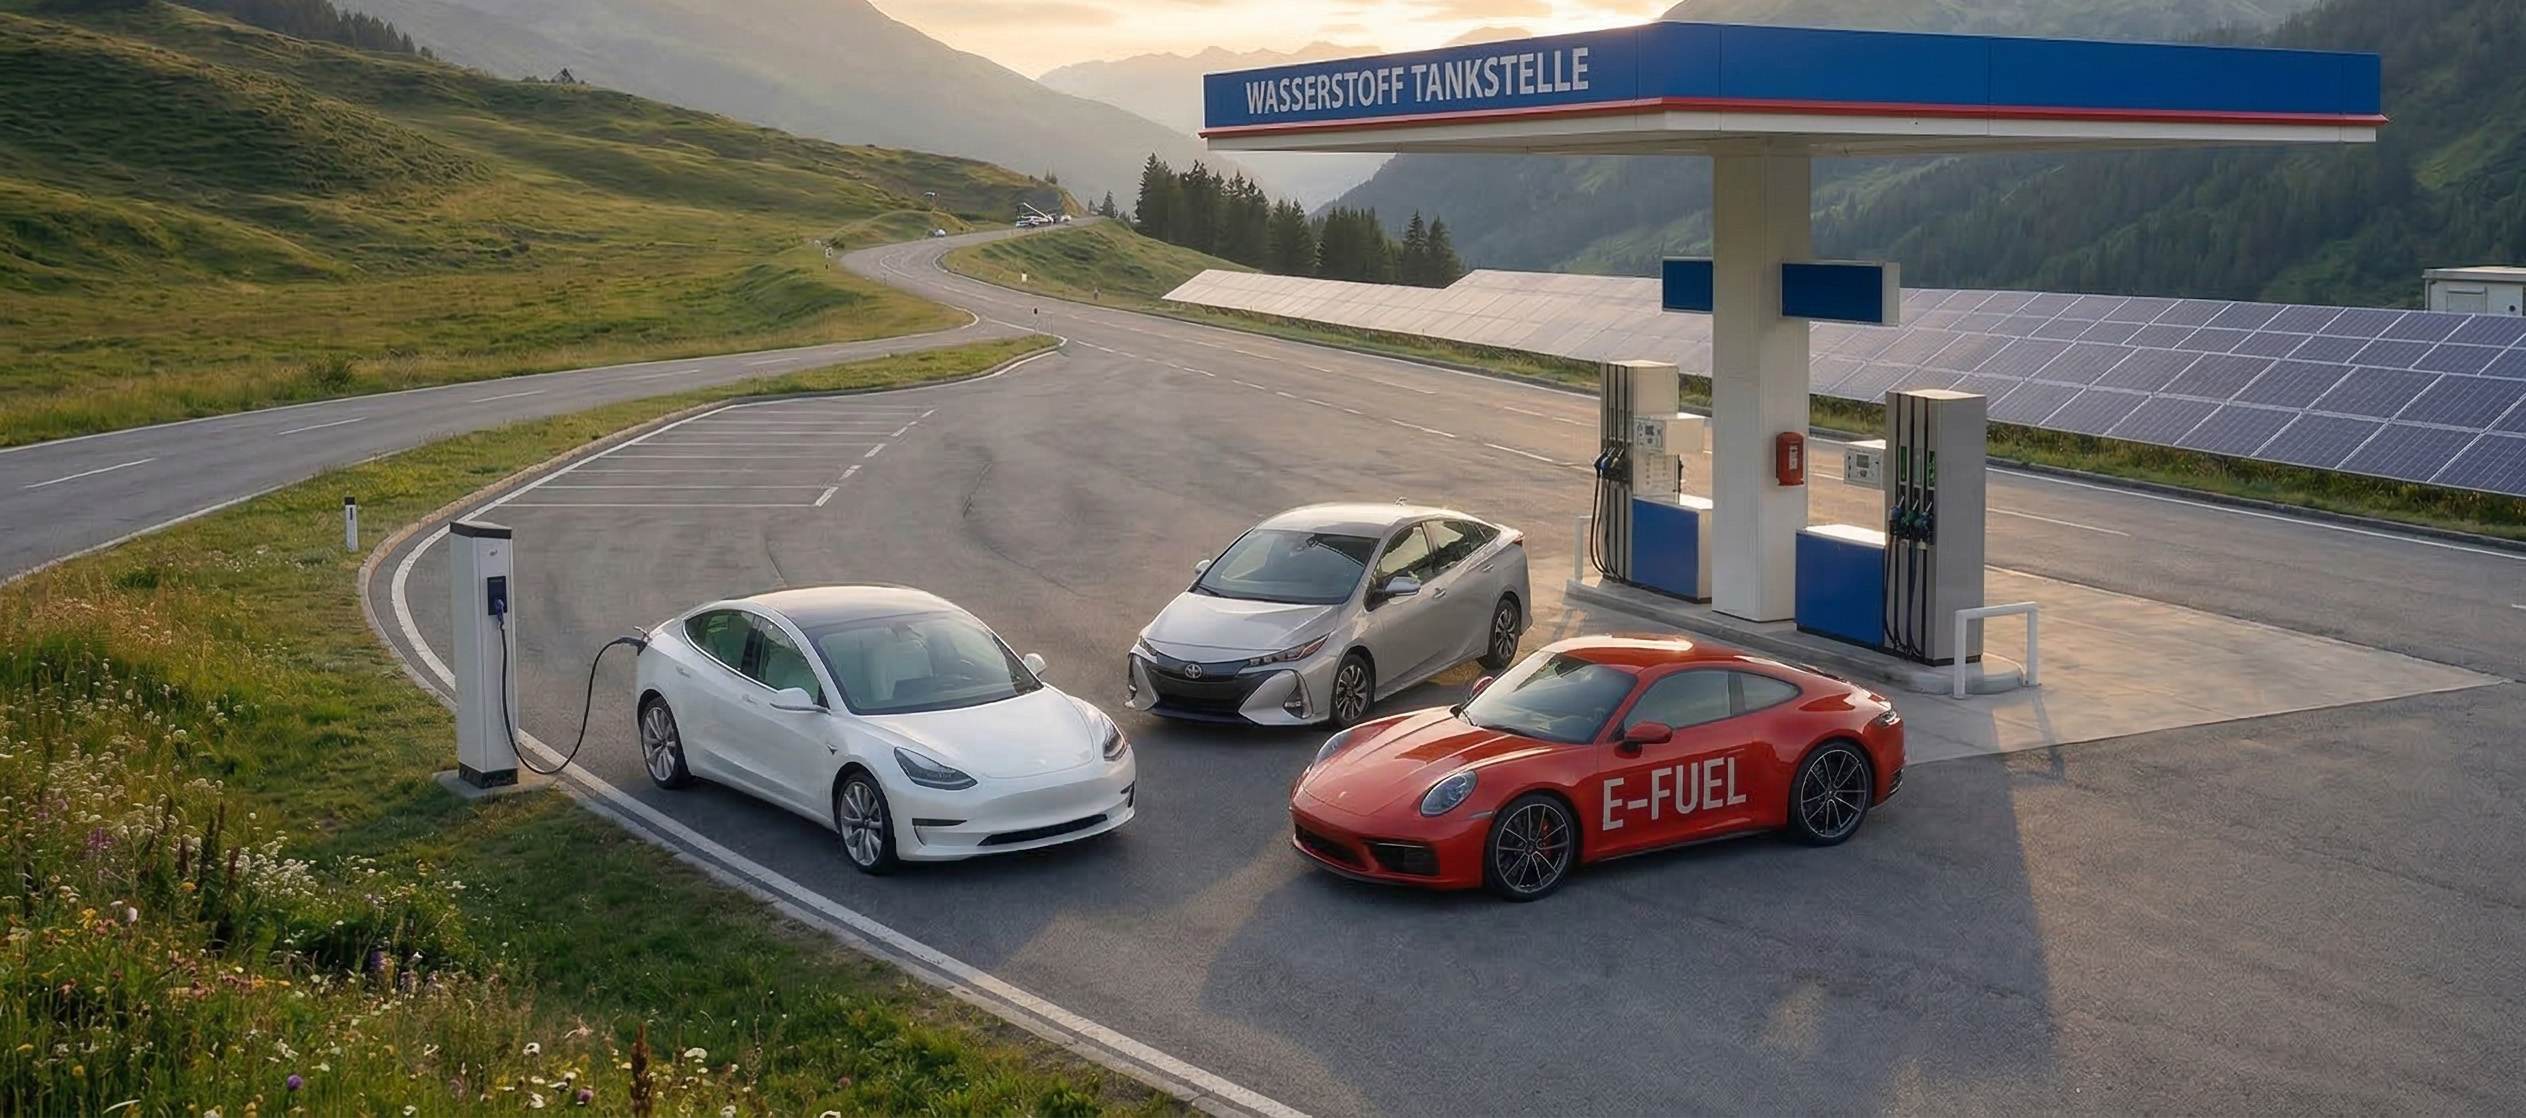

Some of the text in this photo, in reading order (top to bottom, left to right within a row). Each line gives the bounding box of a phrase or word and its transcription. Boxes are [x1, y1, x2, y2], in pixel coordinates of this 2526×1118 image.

[1246, 47, 1589, 115] WASSERSTOFF TANKSTELLE
[1602, 757, 1747, 831] E-FUEL
